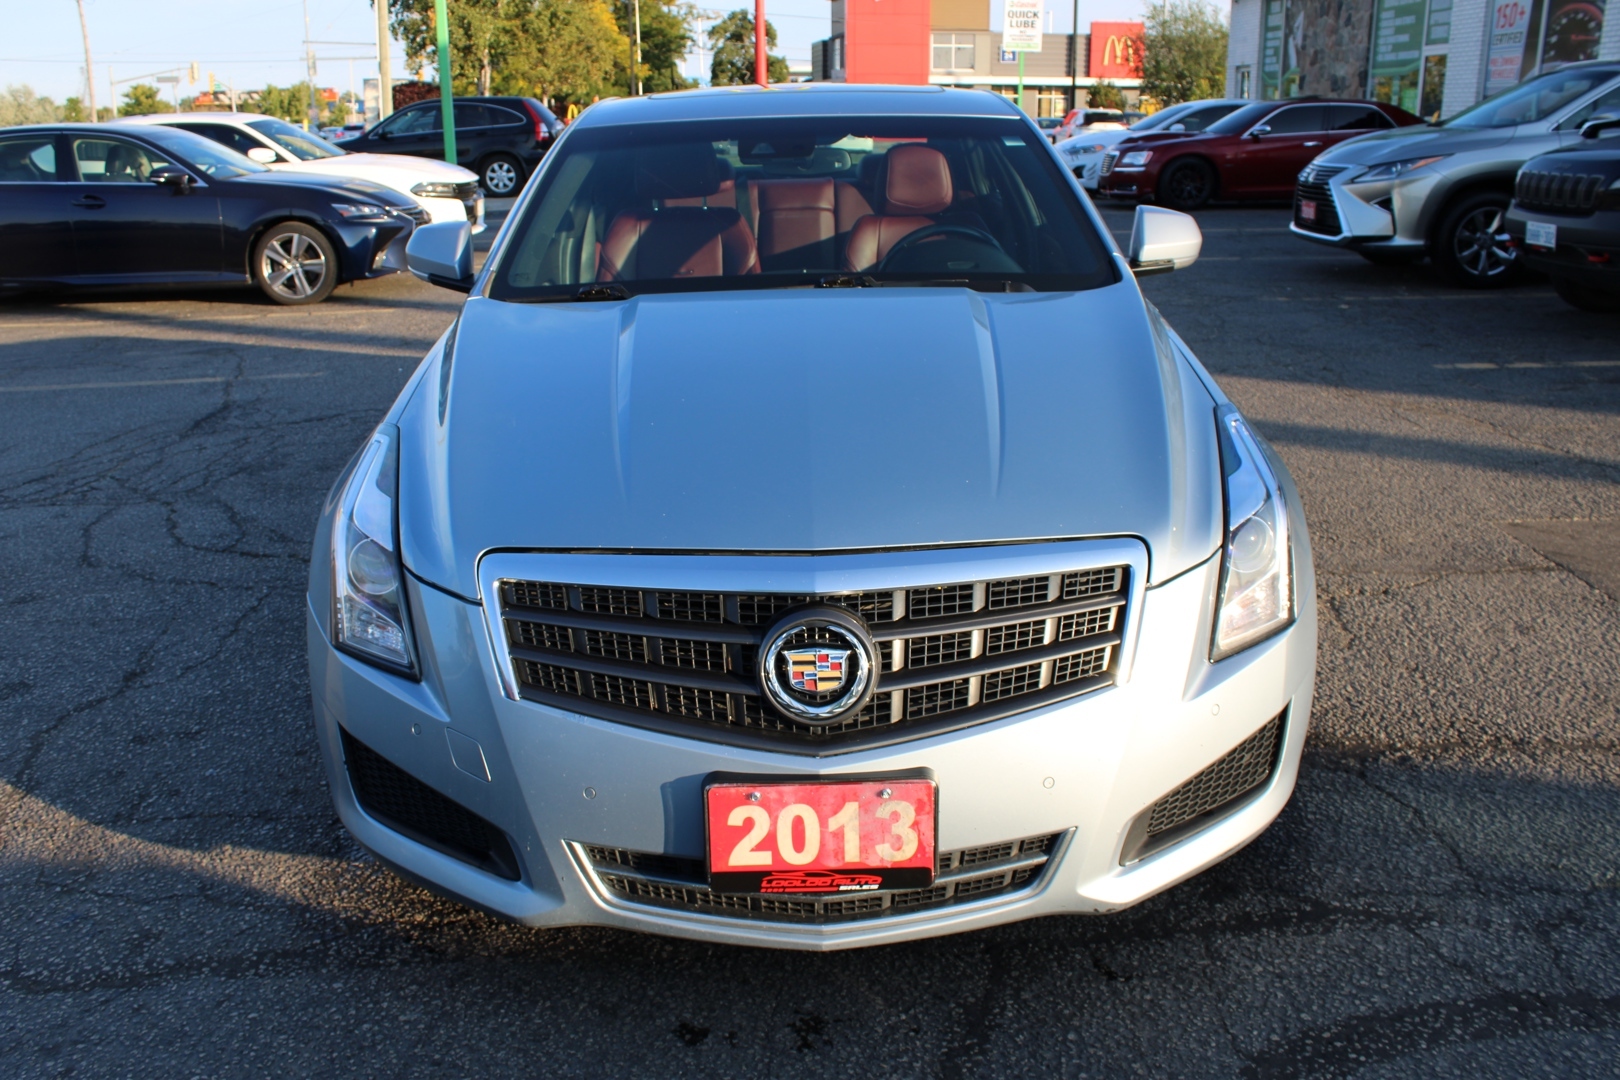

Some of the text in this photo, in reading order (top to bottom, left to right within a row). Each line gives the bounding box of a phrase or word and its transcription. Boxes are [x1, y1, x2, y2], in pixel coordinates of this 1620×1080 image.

[1007, 10, 1040, 19] QUICK
[1495, 2, 1526, 29] 150+
[1009, 20, 1036, 28] LUBE
[727, 800, 919, 866] 2013
[833, 878, 882, 886] AUTO
